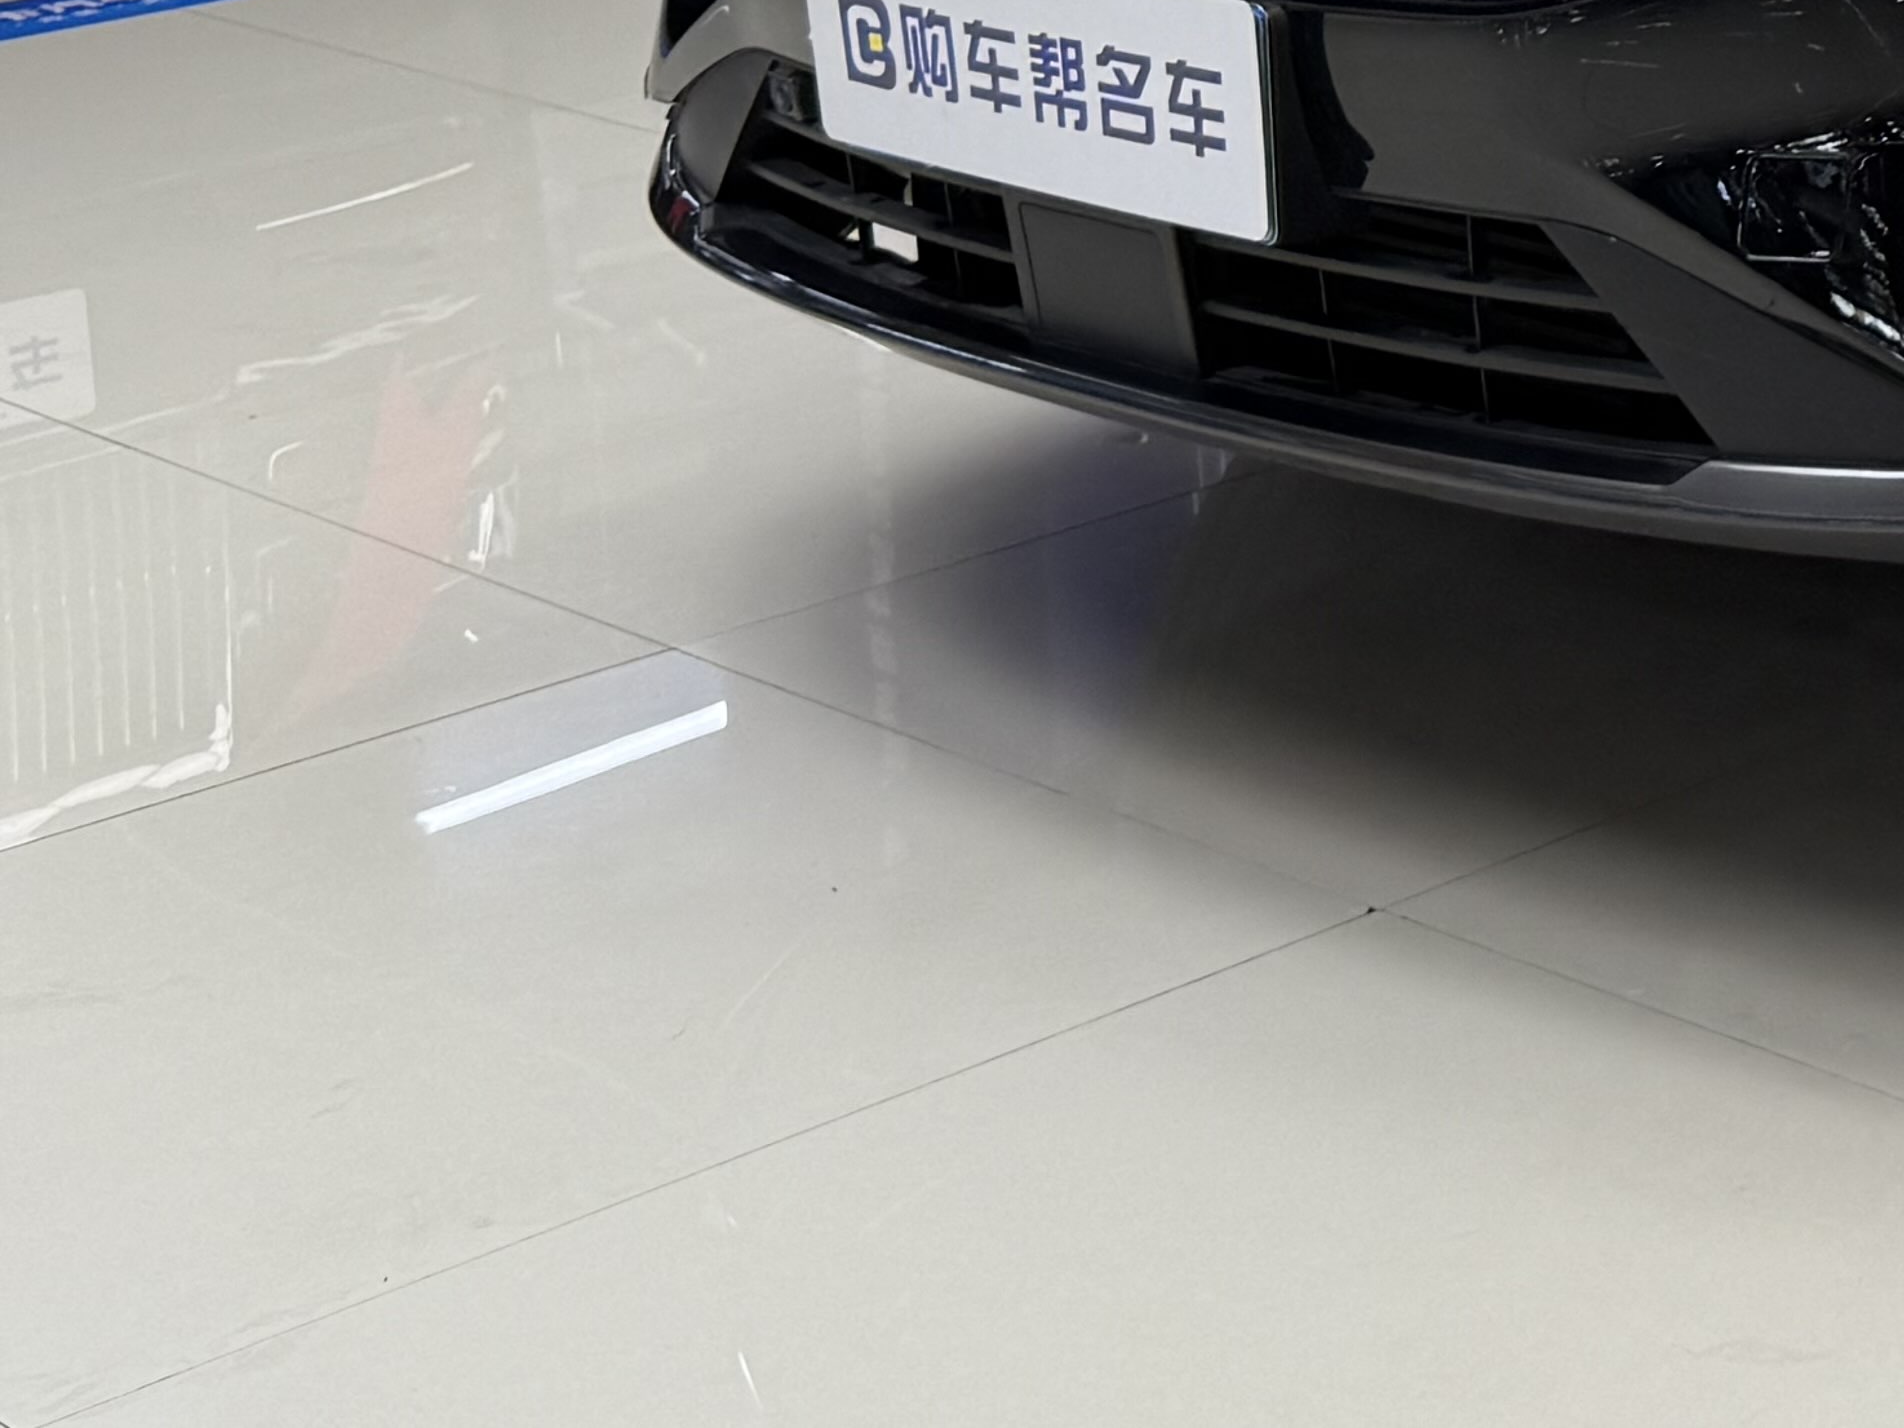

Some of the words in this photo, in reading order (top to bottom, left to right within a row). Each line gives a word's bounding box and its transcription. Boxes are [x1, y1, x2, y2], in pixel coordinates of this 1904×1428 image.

[897, 5, 1229, 158] 购车帮名车
